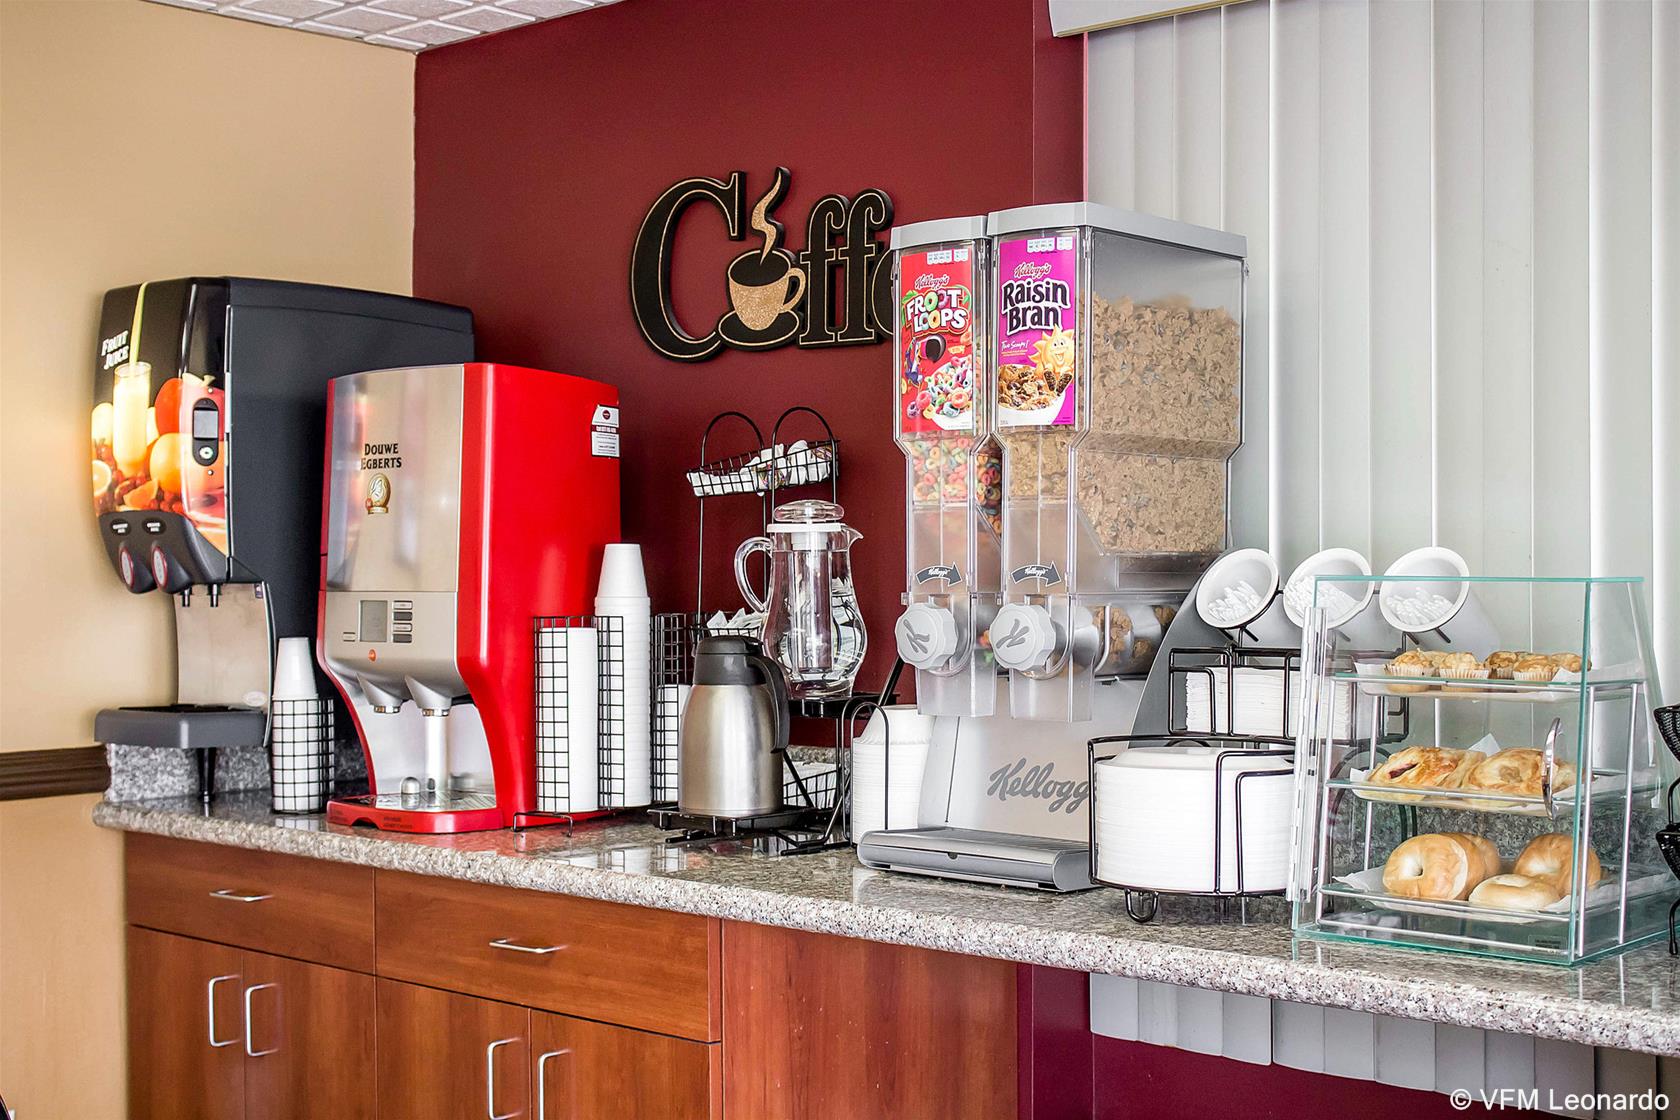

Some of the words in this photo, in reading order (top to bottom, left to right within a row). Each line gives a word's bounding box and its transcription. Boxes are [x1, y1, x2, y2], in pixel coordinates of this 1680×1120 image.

[906, 289, 962, 321] FROOT
[1002, 280, 1069, 312] Raisin
[914, 308, 967, 333] LOOPS
[1008, 305, 1060, 332] Bran
[101, 330, 129, 356] FRUIT
[364, 443, 399, 456] DOUWE
[361, 457, 402, 470] EGBERTS
[987, 757, 1097, 814] Kellogg
